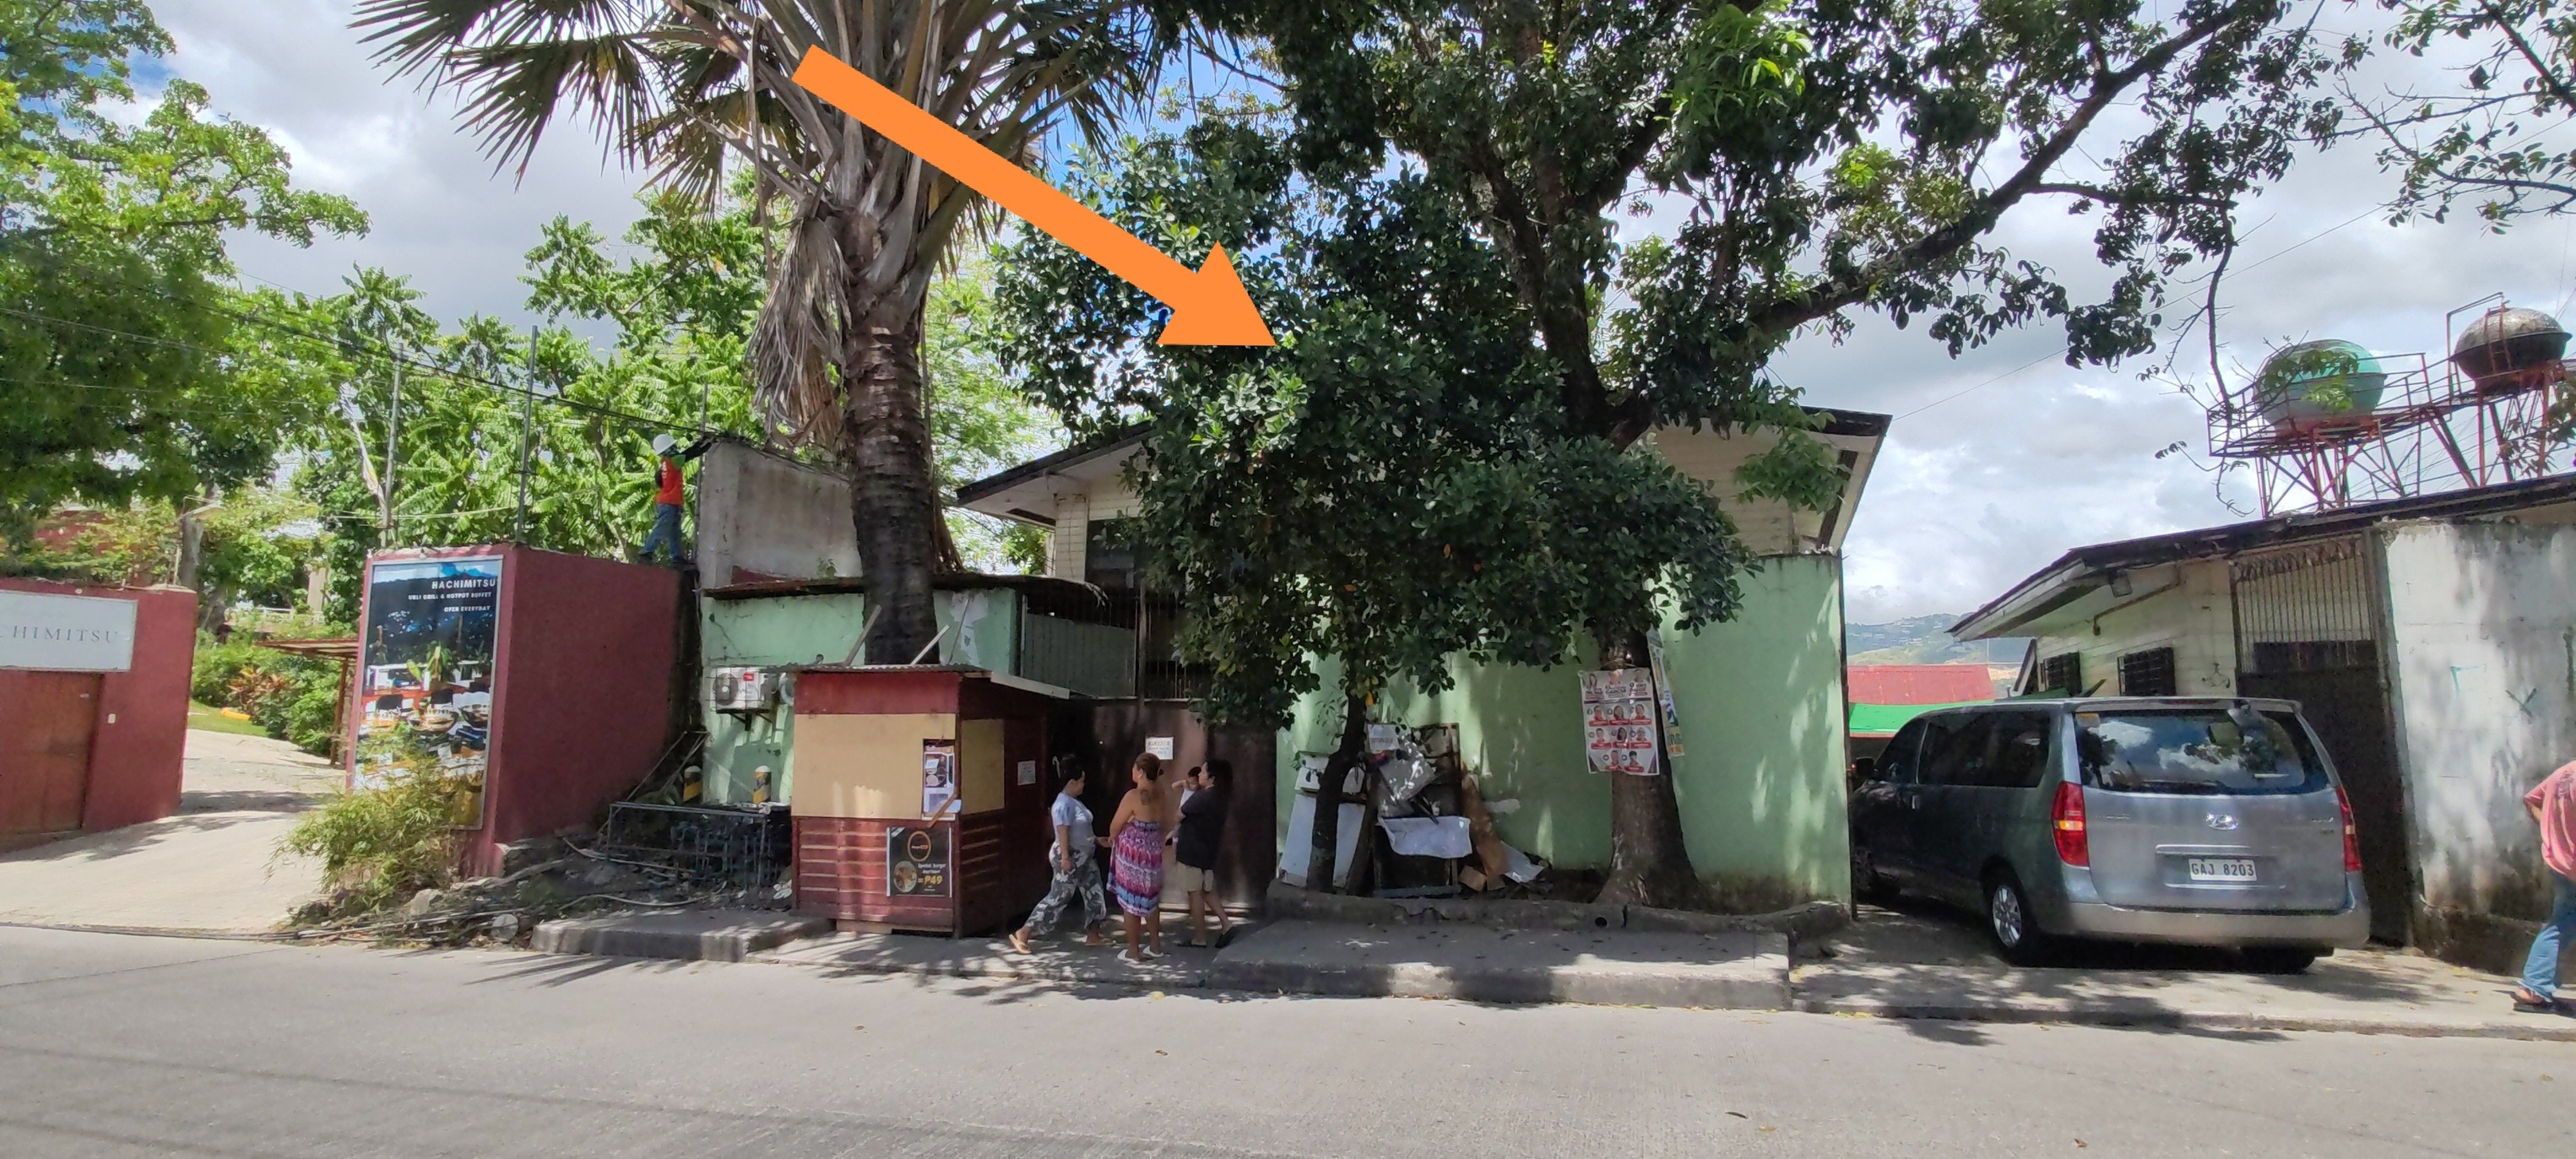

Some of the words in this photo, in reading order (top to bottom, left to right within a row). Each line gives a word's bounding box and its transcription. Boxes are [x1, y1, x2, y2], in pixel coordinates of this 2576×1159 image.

[431, 579, 496, 589] HACHIMITSU
[2191, 864, 2215, 875] GAJ
[2223, 864, 2254, 876] 8203
